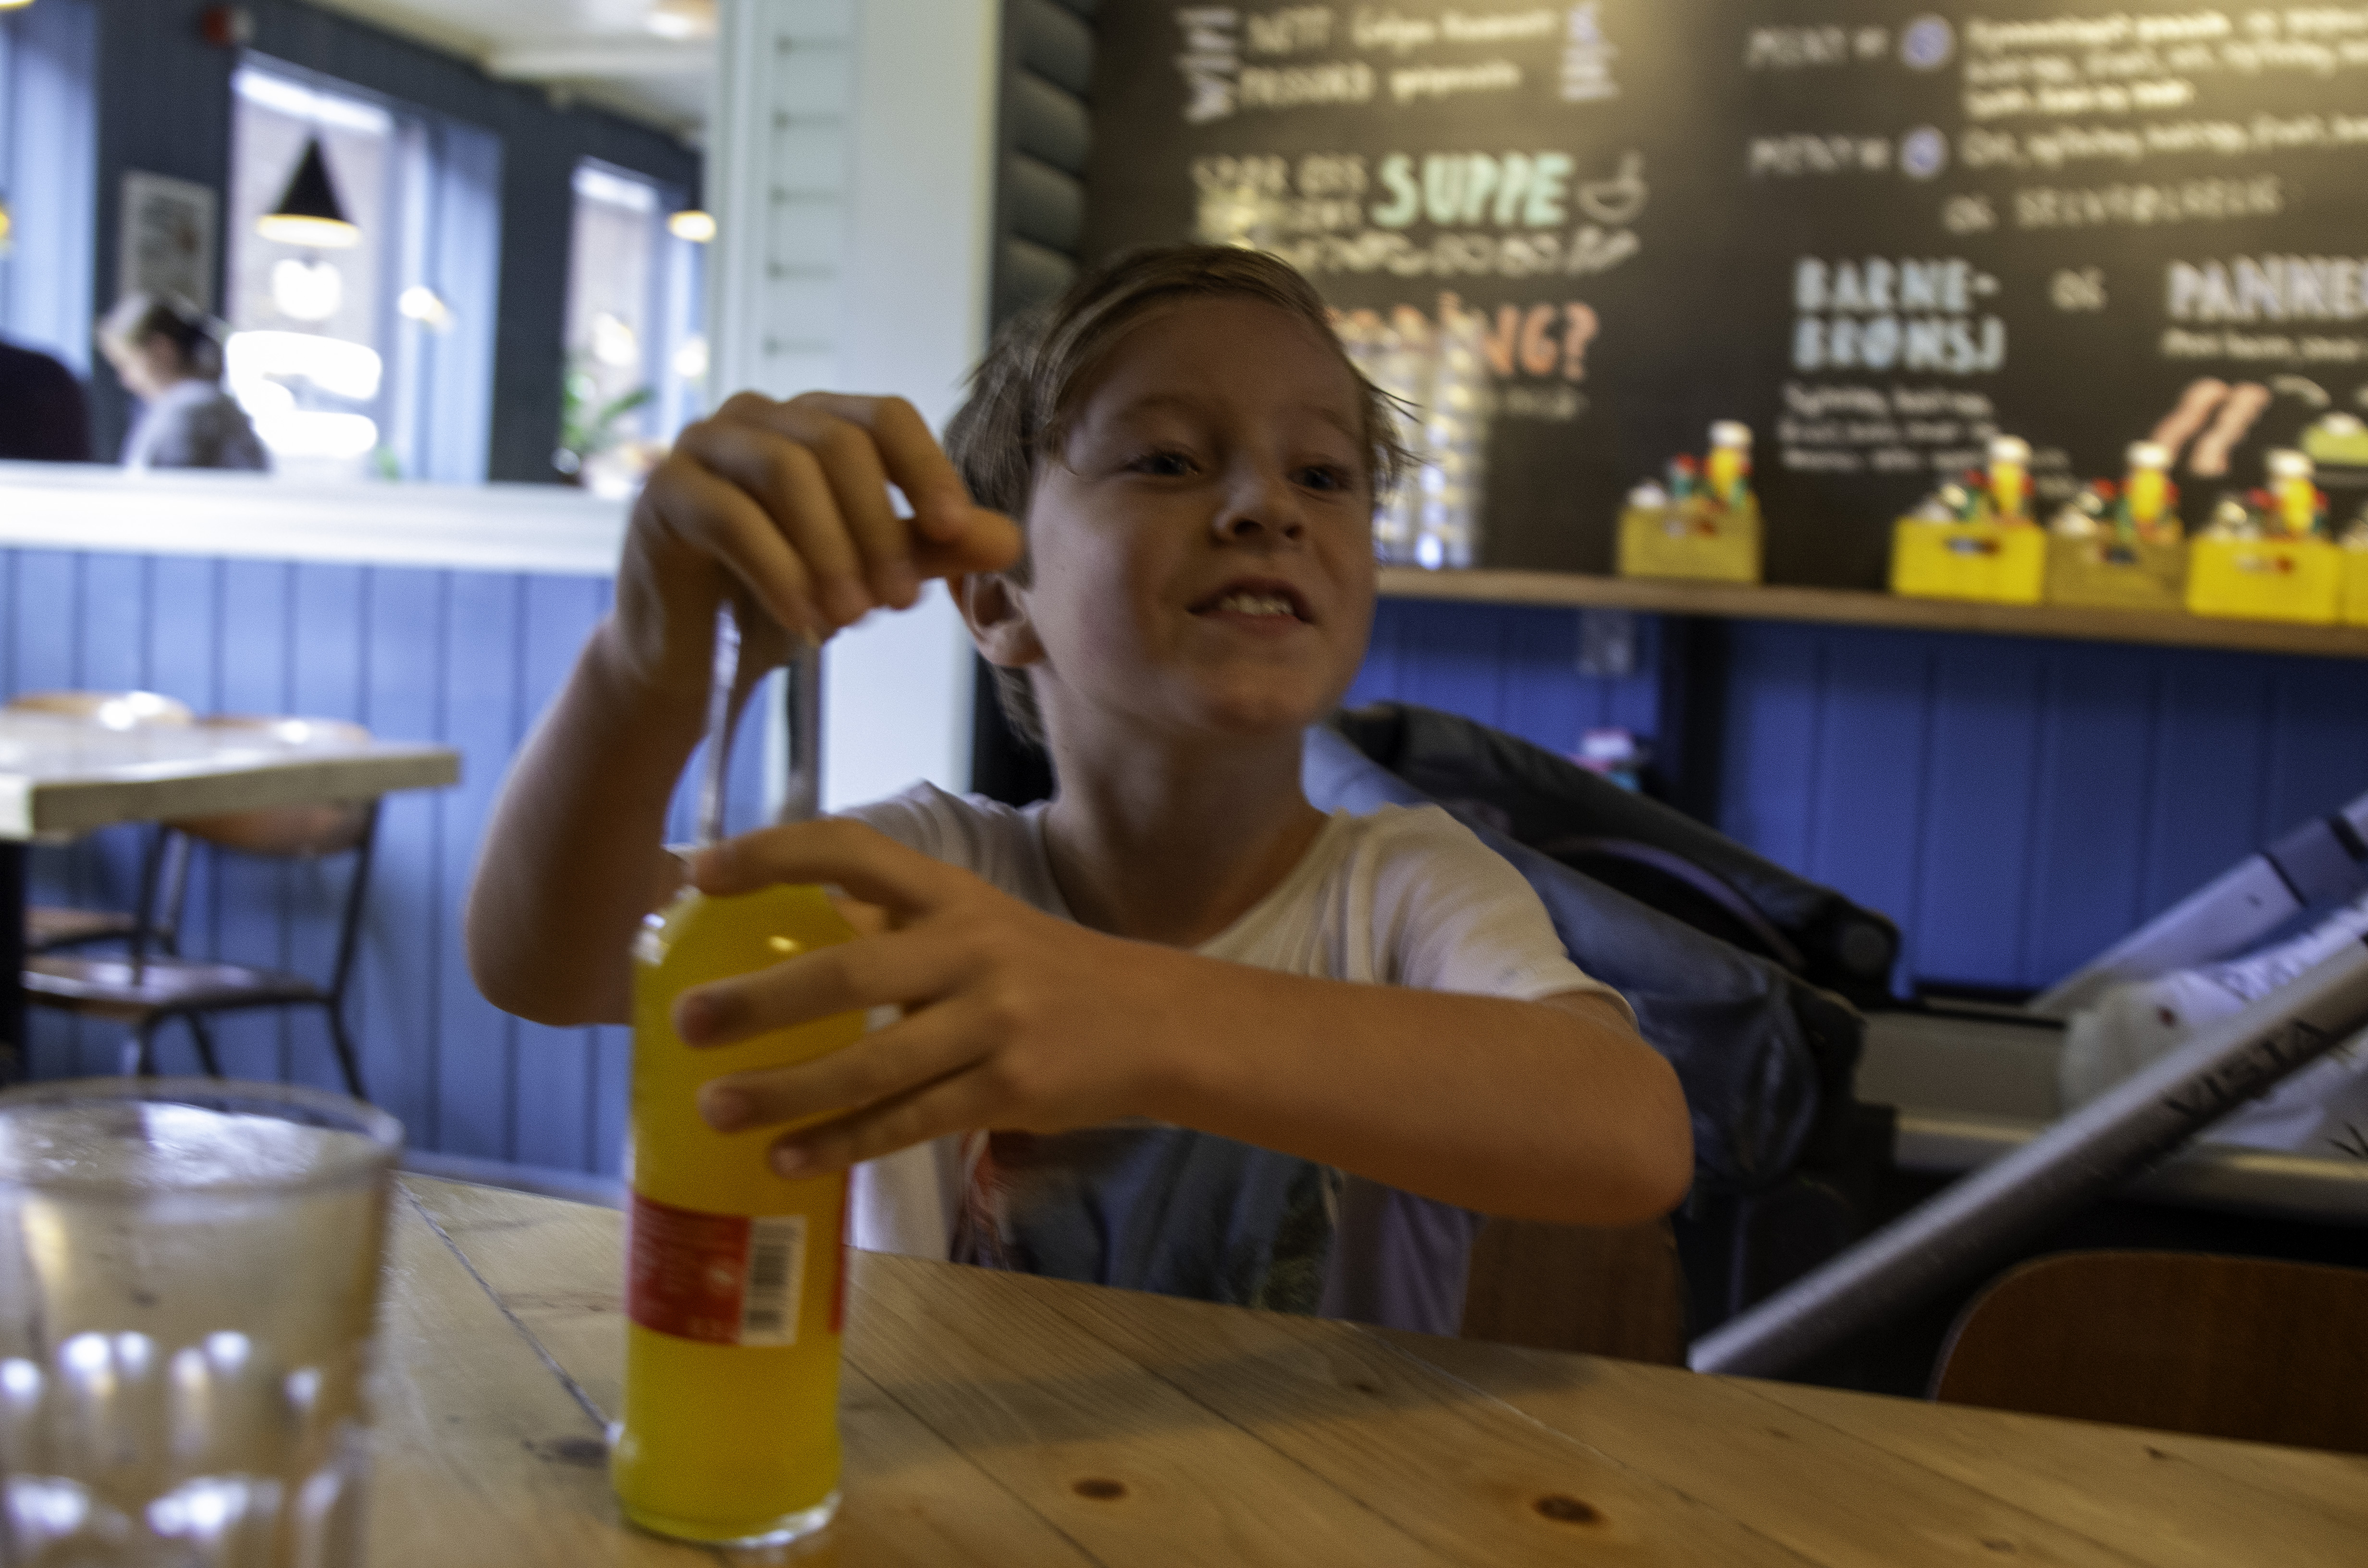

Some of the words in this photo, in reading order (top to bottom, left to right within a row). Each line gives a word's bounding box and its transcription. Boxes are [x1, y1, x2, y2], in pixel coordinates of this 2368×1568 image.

[1372, 152, 1574, 226] SUPPE
[1795, 257, 2000, 313] BARNE-
[2167, 257, 2368, 319] PANNE
[2160, 1017, 2332, 1118] VISTA
